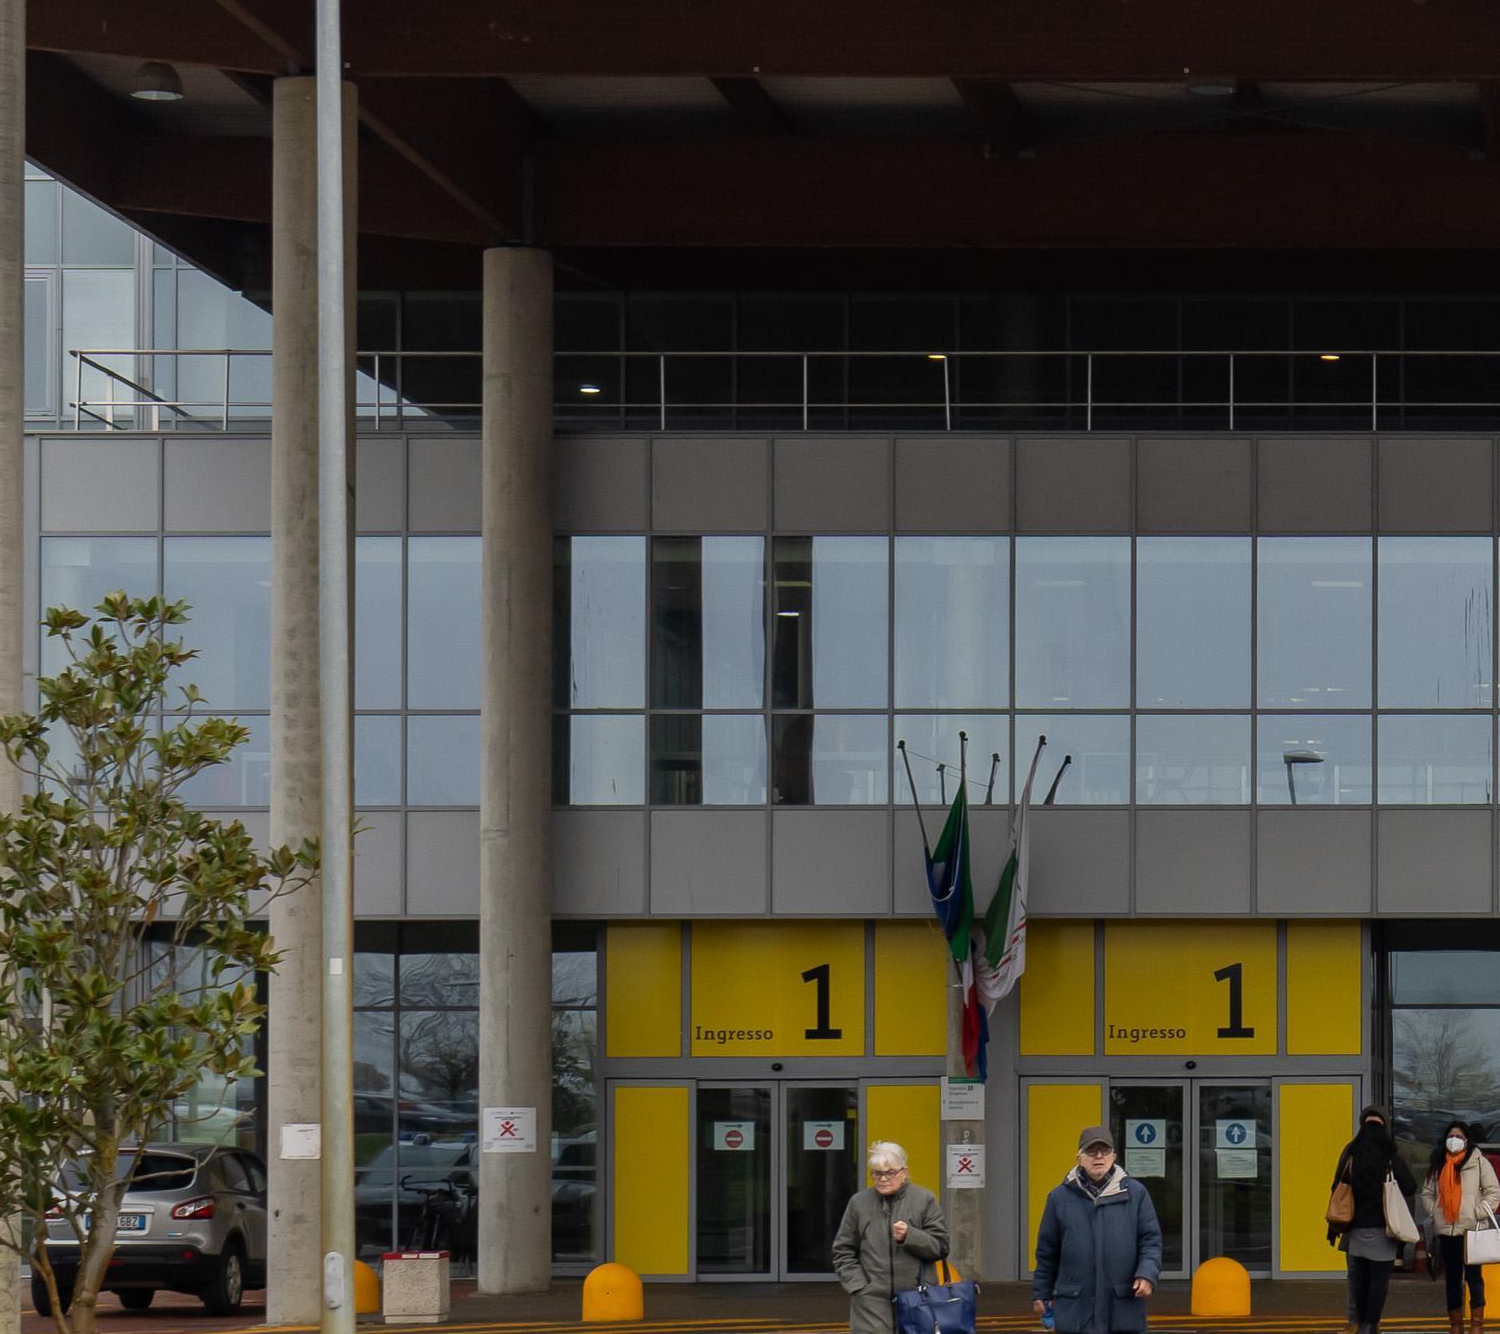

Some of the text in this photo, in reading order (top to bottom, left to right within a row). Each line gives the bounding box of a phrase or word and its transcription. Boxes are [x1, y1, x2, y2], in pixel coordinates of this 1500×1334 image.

[802, 964, 842, 1039] 1
[1213, 962, 1255, 1038] 1
[695, 1026, 773, 1044] Ingresso
[1109, 1025, 1186, 1043] Ingresso
